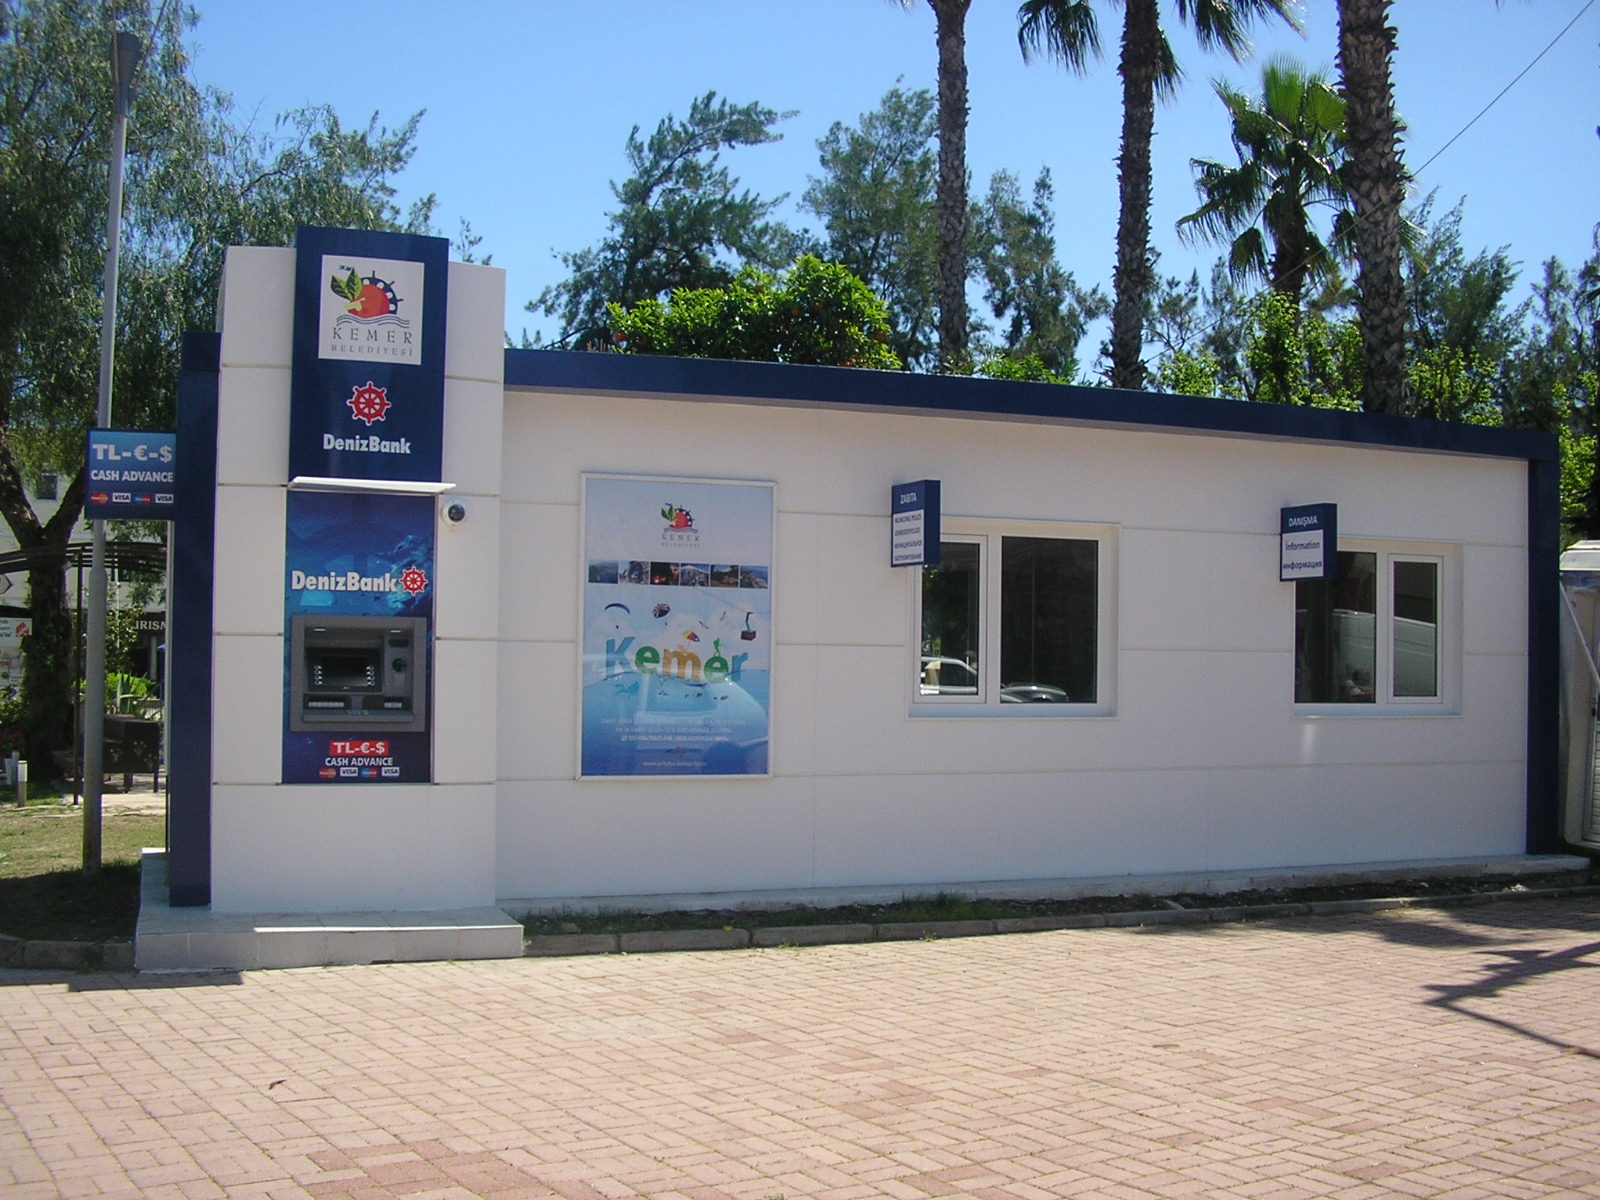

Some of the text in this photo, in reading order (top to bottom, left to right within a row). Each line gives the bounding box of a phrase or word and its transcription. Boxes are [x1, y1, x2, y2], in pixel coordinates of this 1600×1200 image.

[333, 327, 412, 344] KEMER
[331, 344, 412, 356] BELEDİYESİ
[323, 434, 411, 454] DenizBank
[92, 444, 172, 463] TL-€-$
[91, 470, 173, 482] CASH ADVANCE
[1288, 515, 1318, 527] DANIŞMA
[291, 570, 397, 592] DenizBank
[606, 636, 748, 683] Kemer
[333, 742, 385, 755] TL-€-$
[325, 757, 393, 766] CASH ADVANCE
